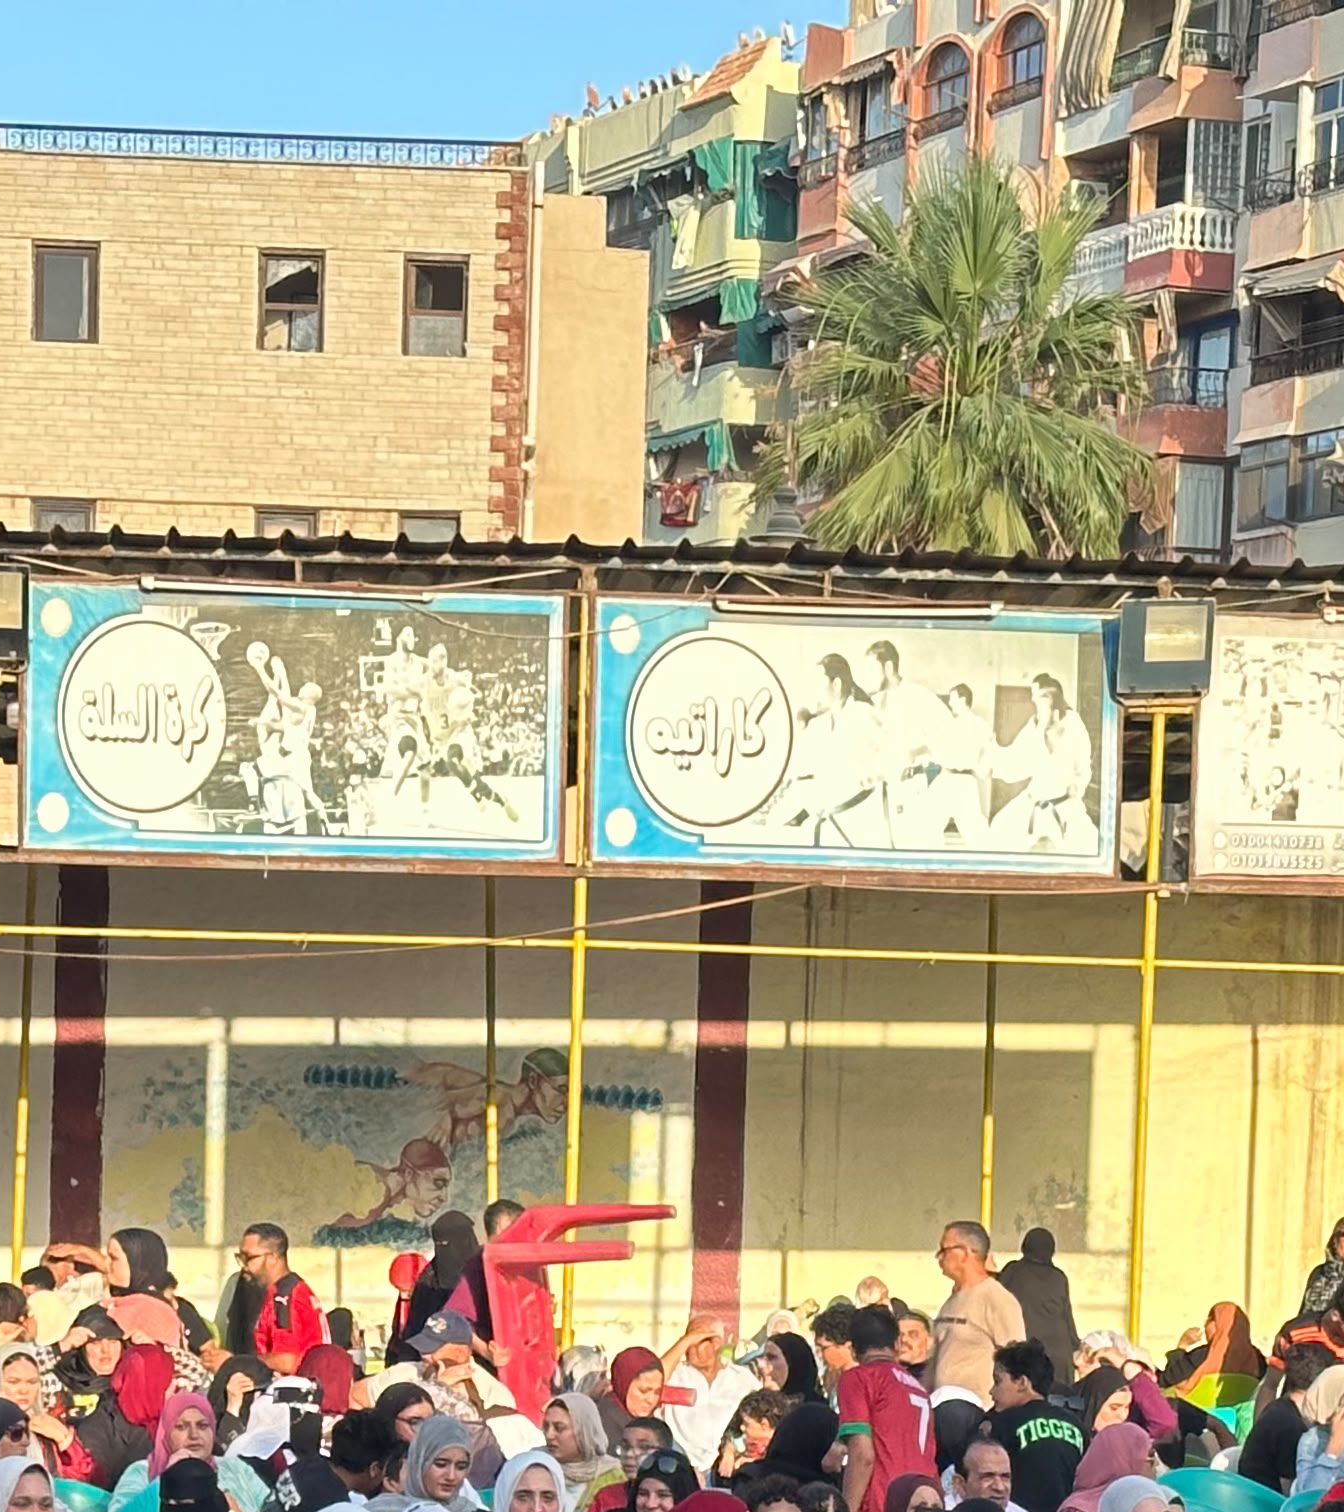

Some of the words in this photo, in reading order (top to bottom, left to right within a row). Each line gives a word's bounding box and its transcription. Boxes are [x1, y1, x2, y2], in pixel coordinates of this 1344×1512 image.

[78, 682, 158, 744] السلة
[163, 674, 214, 762] كرة
[645, 688, 772, 778] كاراتيه
[908, 1393, 930, 1455] 7
